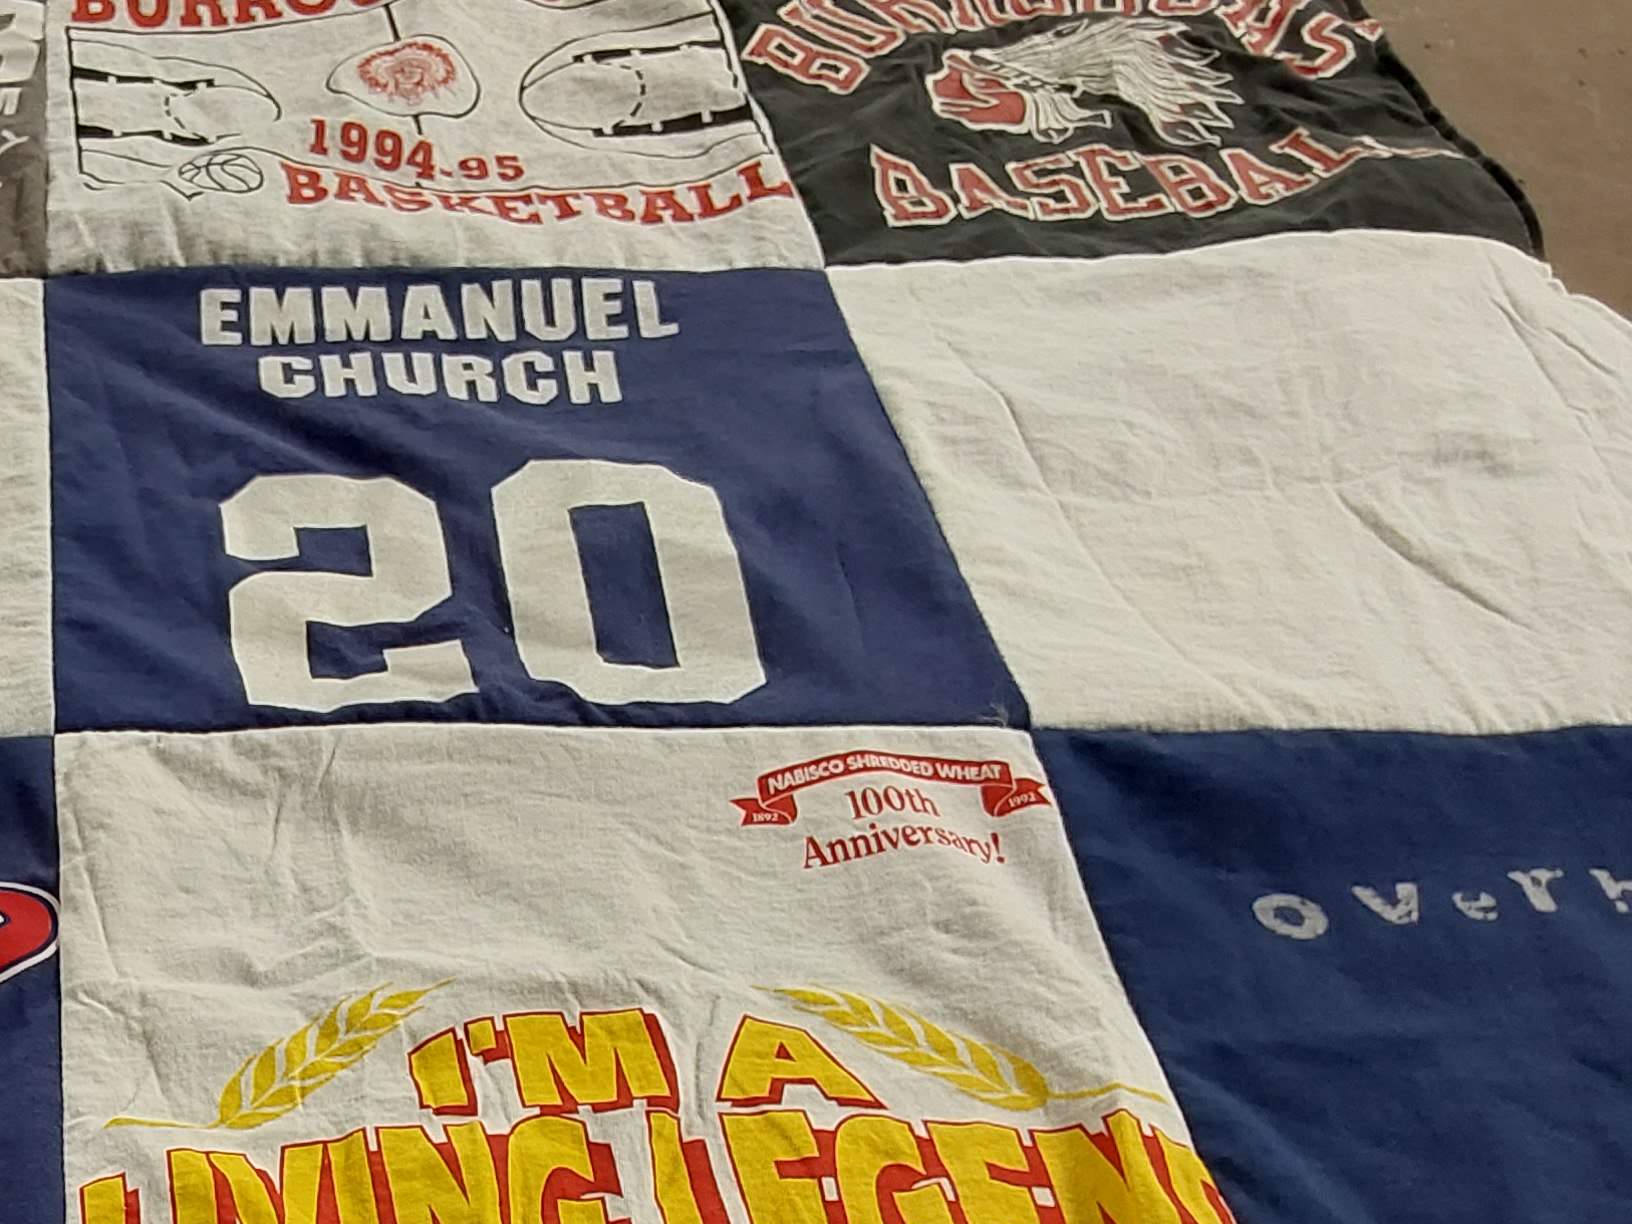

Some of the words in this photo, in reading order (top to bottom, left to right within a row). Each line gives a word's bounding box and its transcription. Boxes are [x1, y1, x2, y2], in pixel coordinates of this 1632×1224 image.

[308, 118, 526, 183] 1994-95
[280, 160, 796, 227] BASKETBALL
[200, 271, 680, 346] EMMANUEL
[258, 349, 623, 404] CHURCH
[219, 459, 767, 714] 20
[767, 761, 846, 794] NABISCO
[847, 752, 934, 778] SHREDDED
[935, 762, 1003, 780] WHEAT
[844, 785, 941, 821] 100th
[751, 811, 780, 824] 1892
[802, 822, 1006, 870] Anniversary!
[408, 1008, 680, 1117] I'M
[715, 1013, 888, 1110] A
